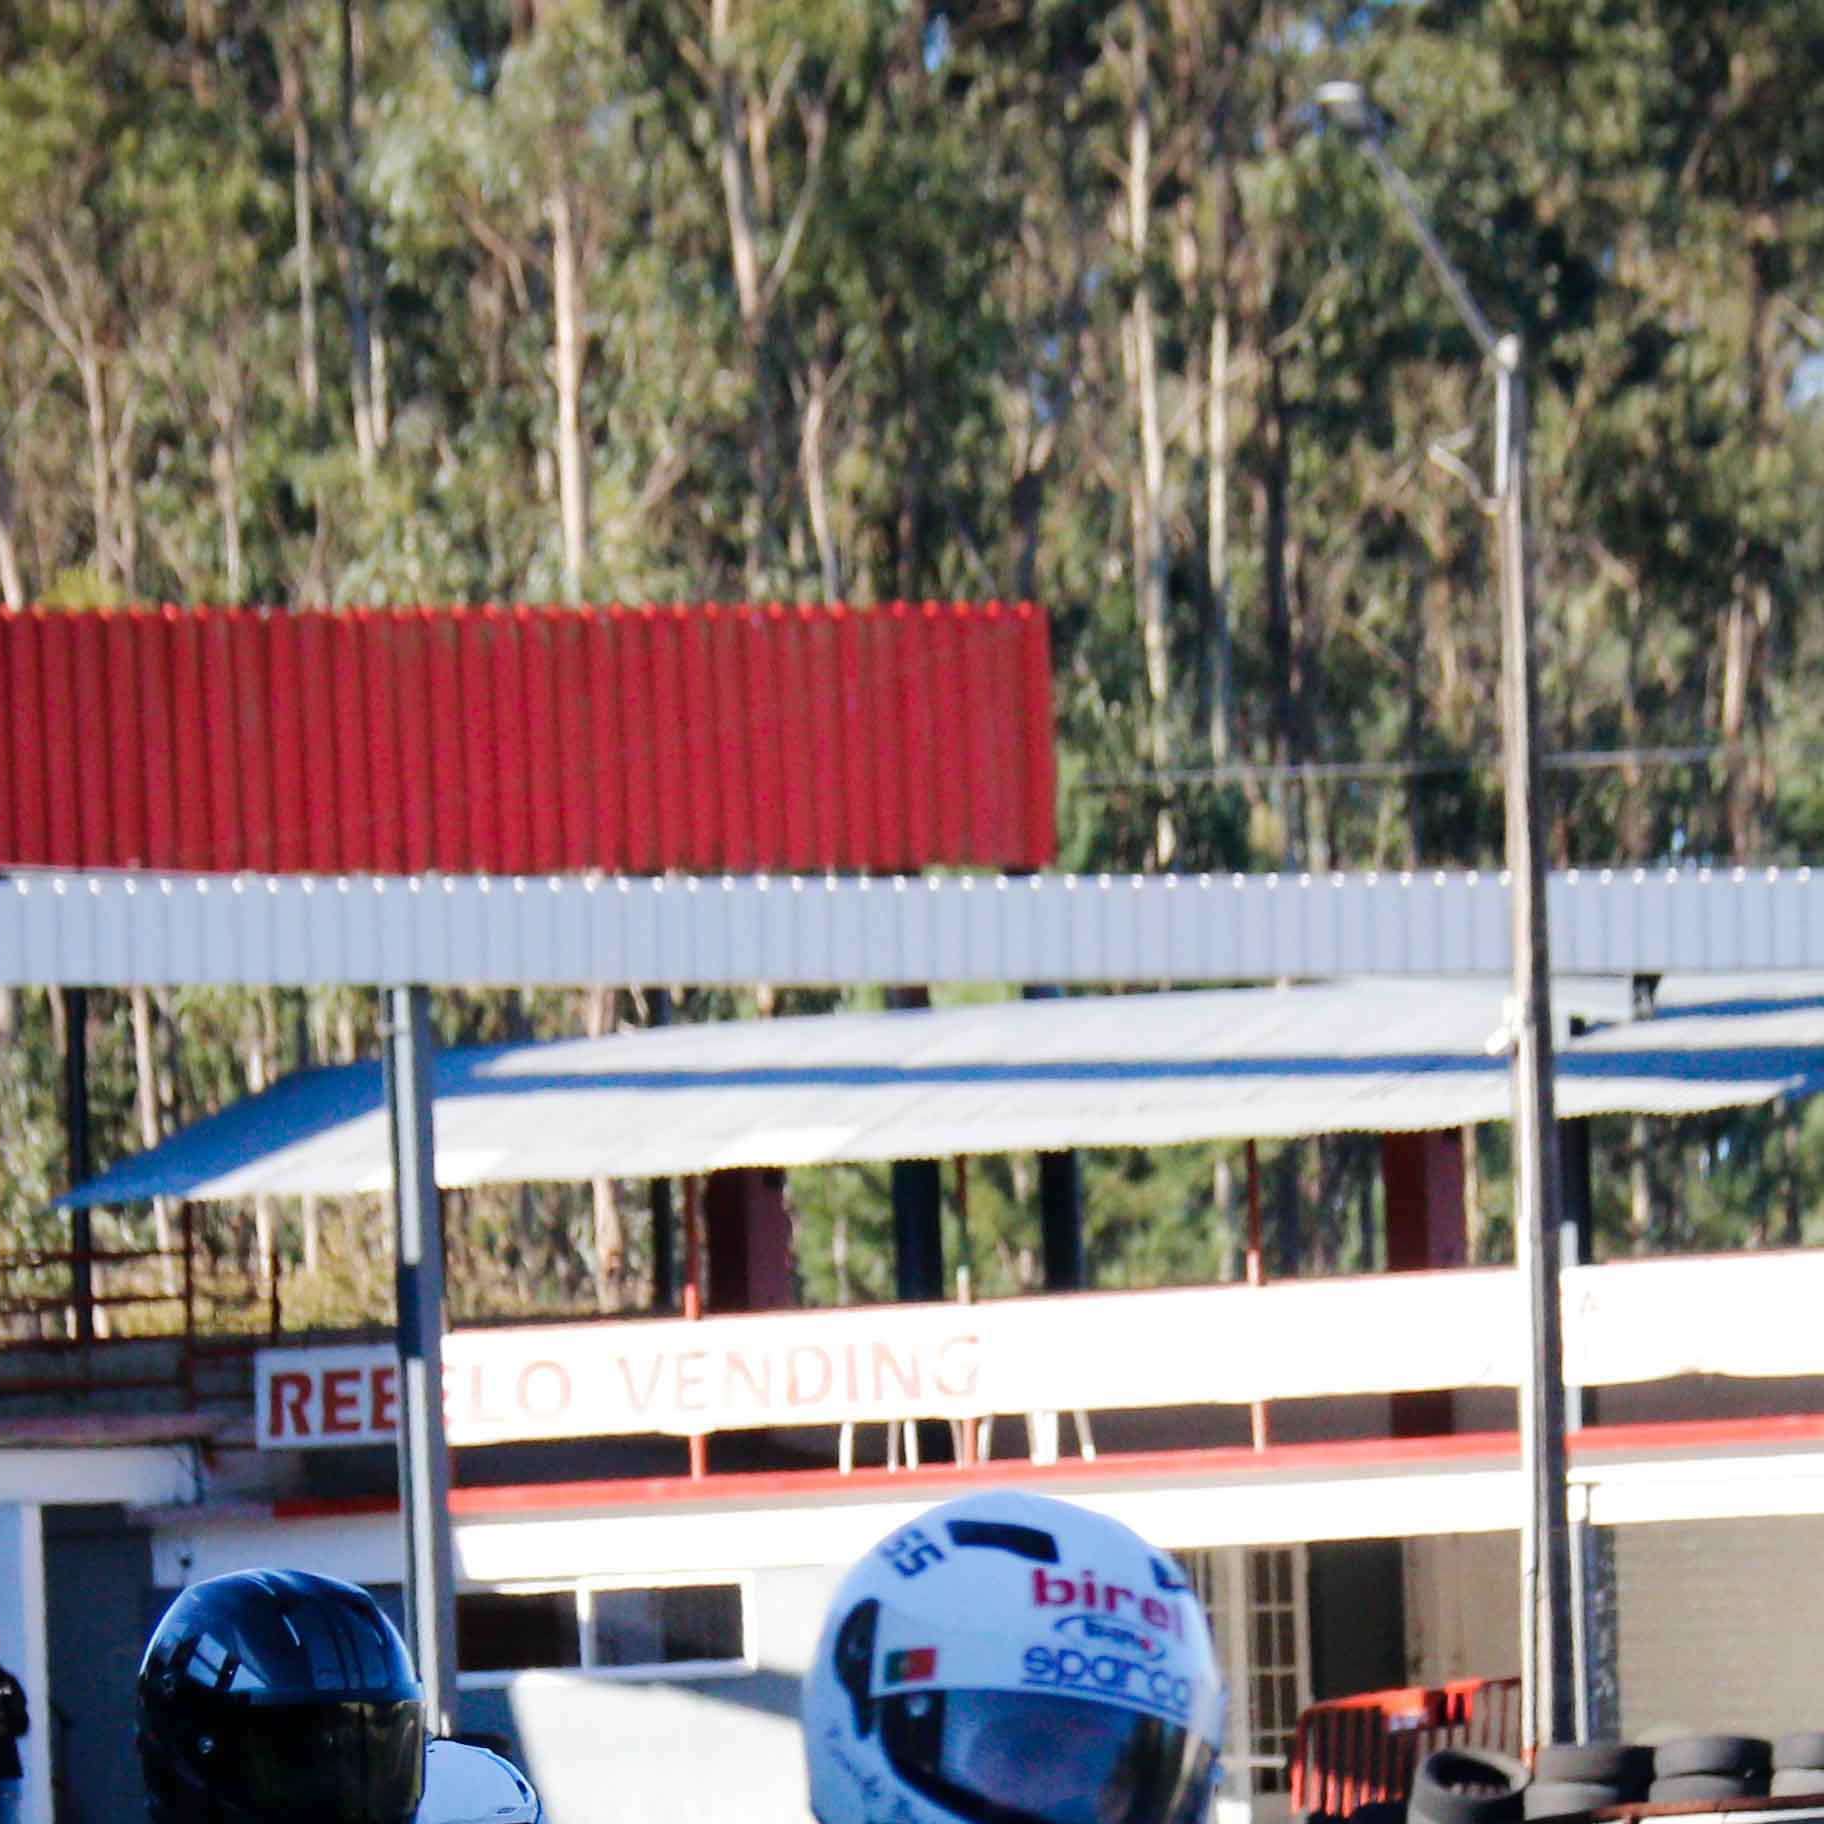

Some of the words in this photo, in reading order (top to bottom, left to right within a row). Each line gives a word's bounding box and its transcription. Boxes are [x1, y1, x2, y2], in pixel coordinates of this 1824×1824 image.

[268, 1359, 572, 1438] REBLO
[616, 1335, 980, 1414] VENDING
[1032, 1566, 1184, 1641] birel
[1023, 1646, 1191, 1708] sparco
